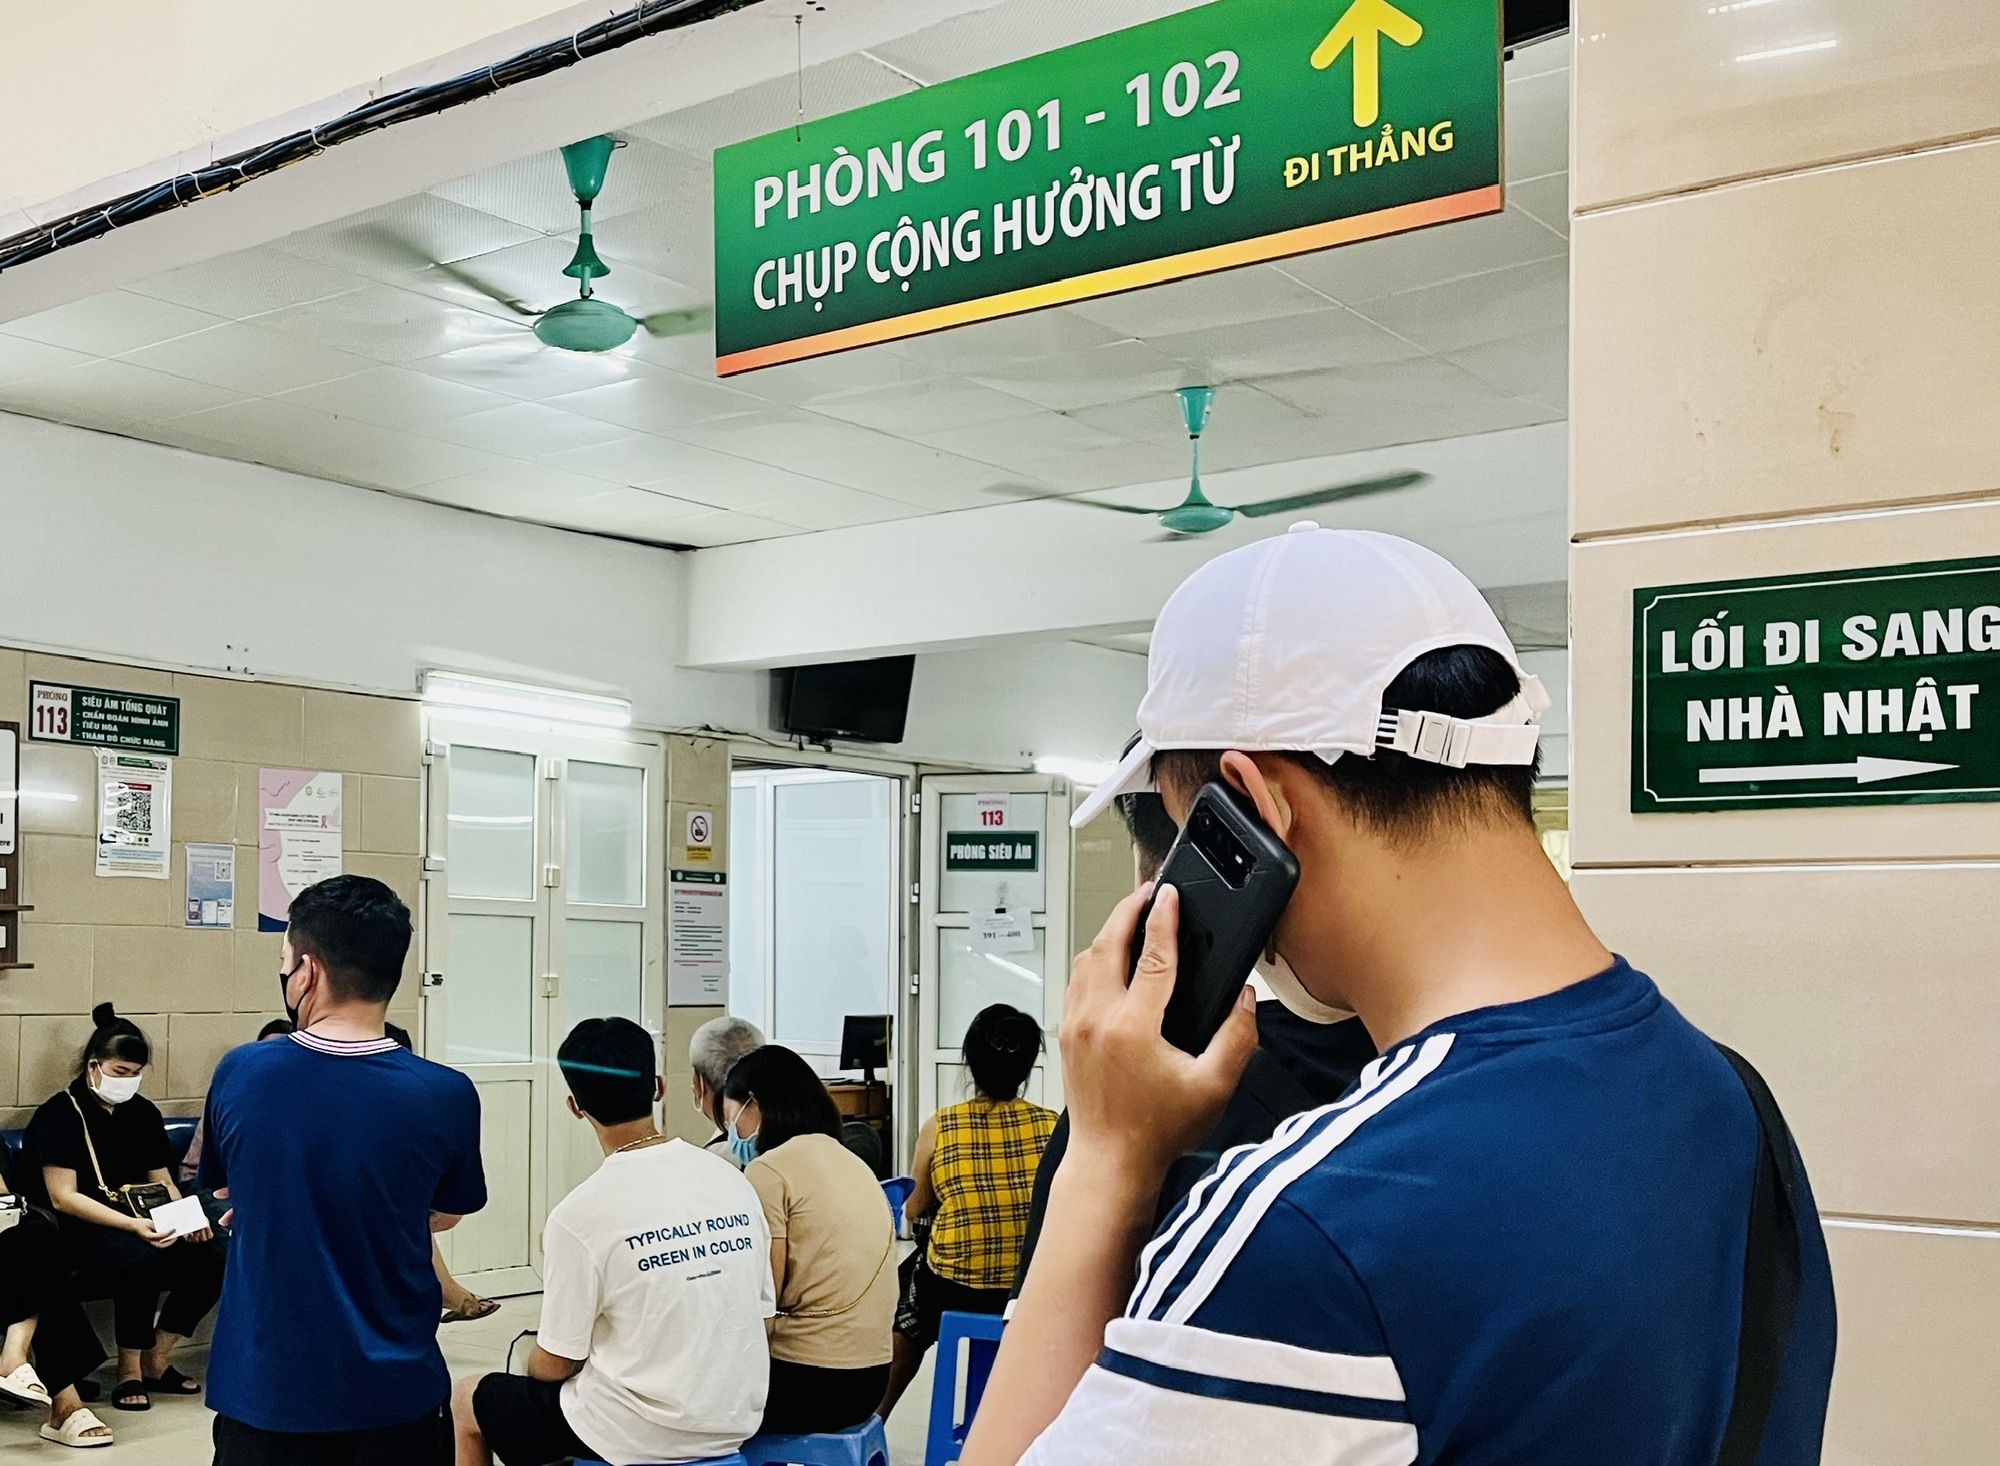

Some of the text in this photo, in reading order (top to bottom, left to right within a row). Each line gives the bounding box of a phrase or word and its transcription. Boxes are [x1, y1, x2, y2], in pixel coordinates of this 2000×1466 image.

[754, 129, 945, 228] PHÒNG
[964, 98, 1060, 170] 101
[1126, 50, 1241, 127] 102
[1283, 121, 1454, 188] ĐI THẲNG
[753, 134, 1241, 312] CHỤP CỘNG HƯỞNG TỪ
[1662, 605, 2000, 673] LỐI ĐI SANG
[36, 704, 68, 735] 113
[82, 695, 102, 708] SIÊU
[1687, 676, 1979, 742] NHÀ NHẬT
[980, 810, 1004, 826] 113
[950, 843, 986, 859] PHÒNG
[988, 842, 1012, 859] SIÊU
[625, 1213, 750, 1250] TYPICALLY ROUND
[638, 1237, 753, 1272] GREEN IN COLOR
